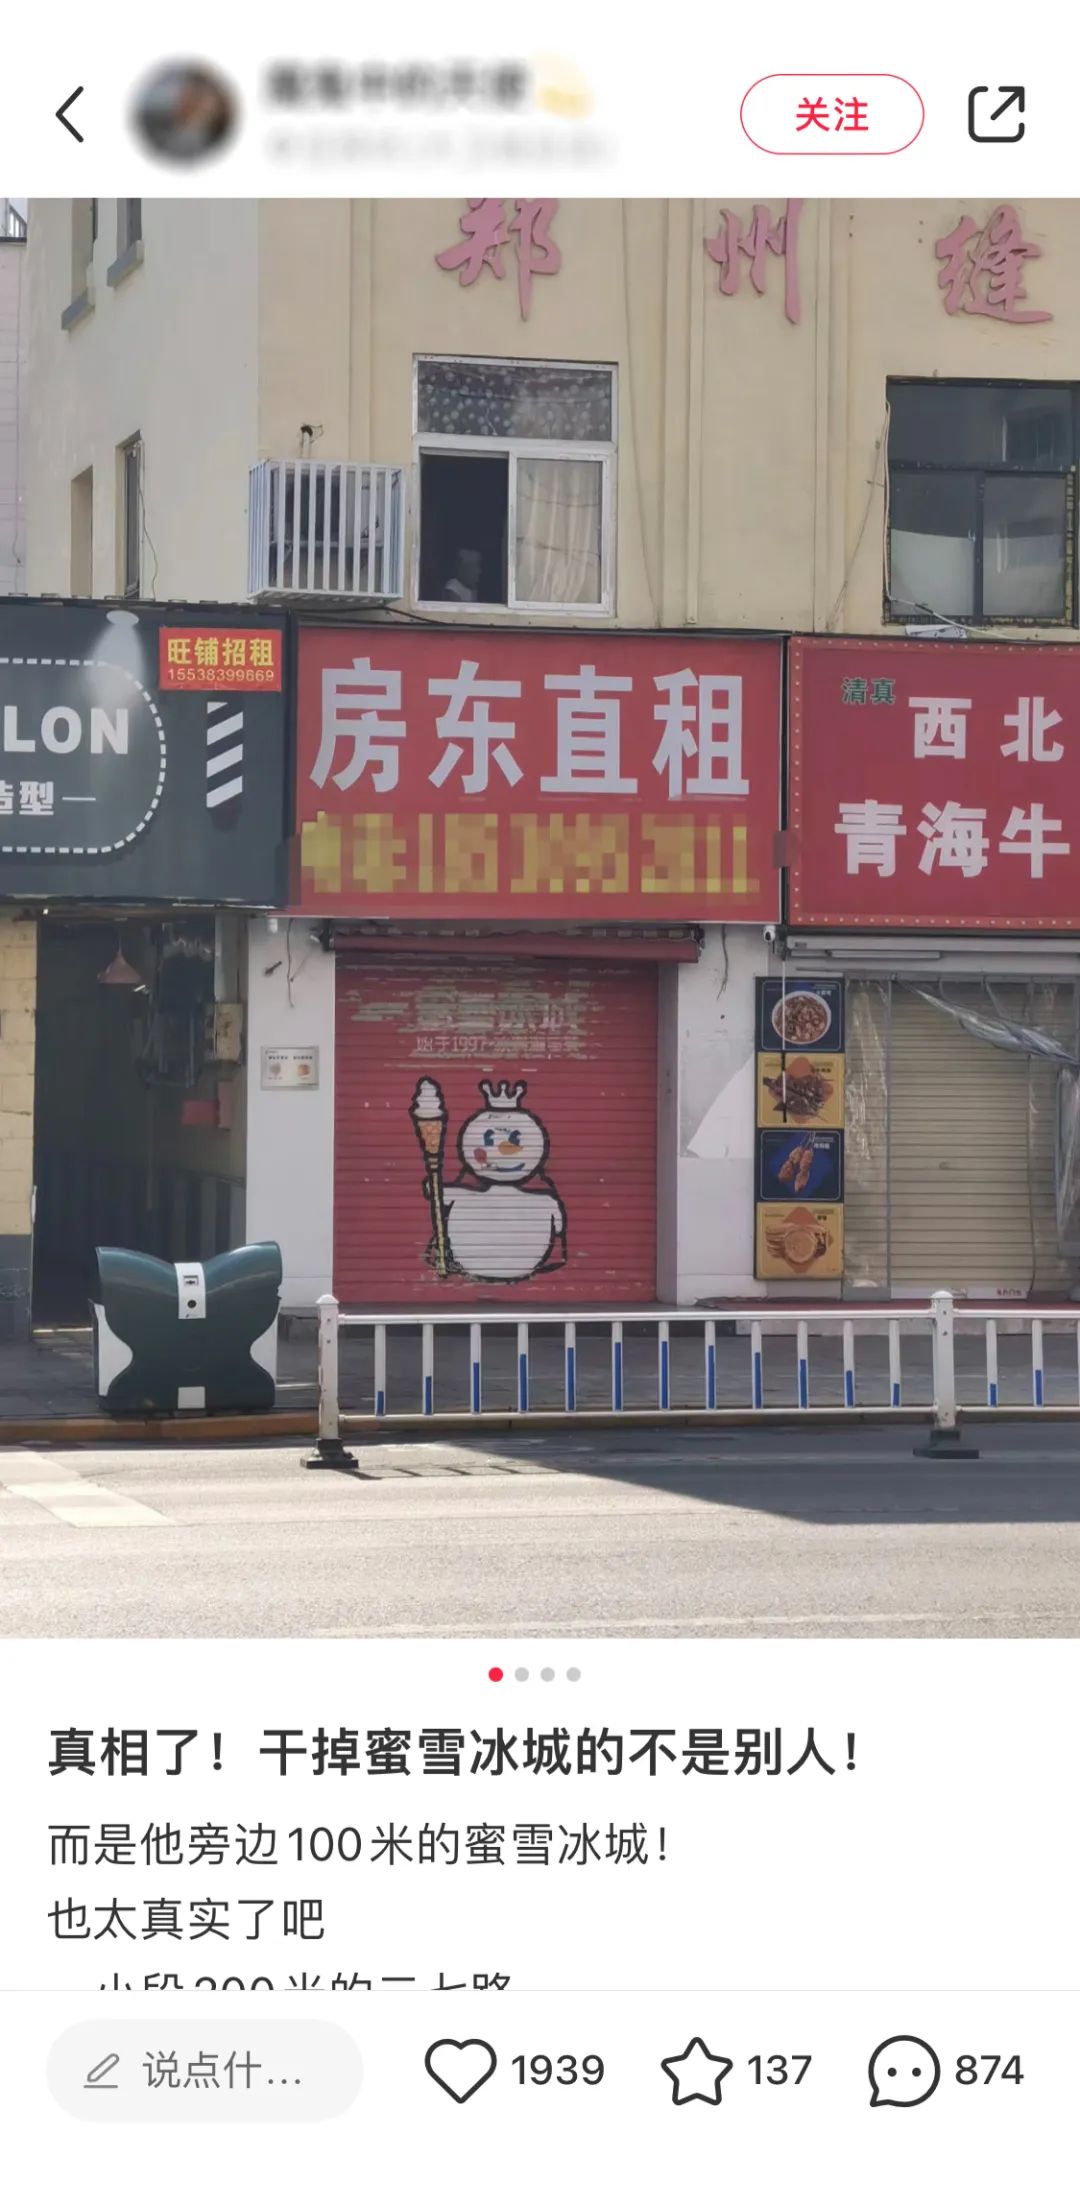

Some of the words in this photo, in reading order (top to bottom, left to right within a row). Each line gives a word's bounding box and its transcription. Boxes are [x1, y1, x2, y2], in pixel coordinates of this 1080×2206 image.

[167, 637, 274, 667] 旺铺招租
[167, 667, 275, 682] 15538399669
[840, 677, 896, 706] 清真
[3, 704, 129, 755] LON
[309, 656, 750, 797] 房东直租
[908, 696, 1065, 763] 西北
[833, 799, 1071, 879] 青海牛
